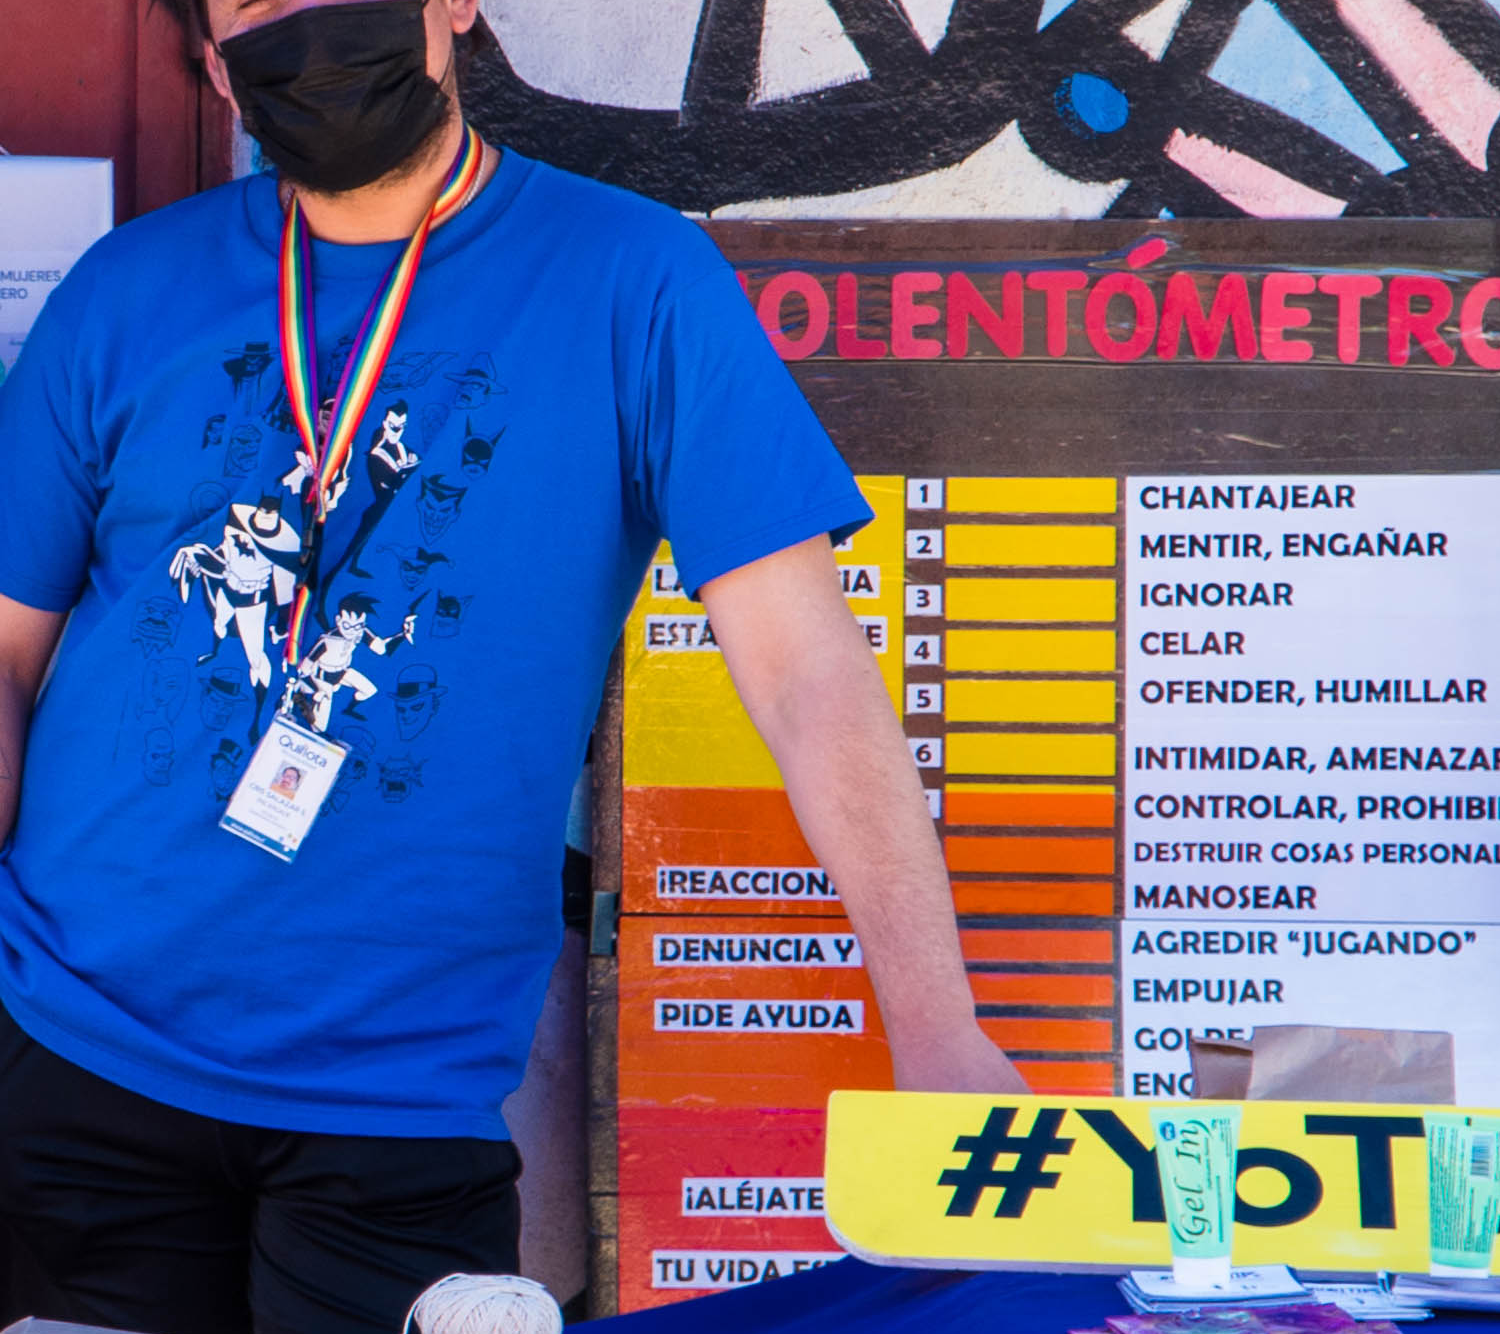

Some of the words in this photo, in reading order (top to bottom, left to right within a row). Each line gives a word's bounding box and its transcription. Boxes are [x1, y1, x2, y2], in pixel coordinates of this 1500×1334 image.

[1, 269, 62, 283] MUJERES
[917, 483, 929, 504] 1
[1139, 484, 1356, 512] CHANTAJEAR
[916, 535, 932, 555] 2
[1140, 533, 1273, 562] MENTIR,
[1282, 526, 1448, 558] ENGAÑAR
[915, 588, 931, 608] 3
[1139, 582, 1294, 607] IGNORAR
[914, 640, 931, 660] 4
[1139, 630, 1246, 656] CELAR
[916, 688, 932, 708] 5
[1139, 679, 1305, 707] OFENDER,
[1315, 678, 1488, 705] HUMILLAR
[915, 743, 932, 763] 6
[1133, 746, 1317, 774] INTIMIDAR,
[1133, 794, 1348, 824] CONTROLAR,
[1133, 842, 1263, 864] DESTRUIR
[1270, 842, 1354, 864] COSAS
[659, 870, 841, 897] ¡REACCION
[1133, 884, 1317, 910] MANOSEAR
[659, 938, 825, 963] DENUNCIA
[833, 938, 855, 963] Y
[1132, 930, 1278, 955] AGREDIR
[1132, 978, 1284, 1006] EMPUJAR
[660, 1003, 734, 1028] PIDE
[742, 1004, 855, 1029] AYUDA
[656, 1258, 696, 1282] TU
[705, 1259, 781, 1283] VIDA
